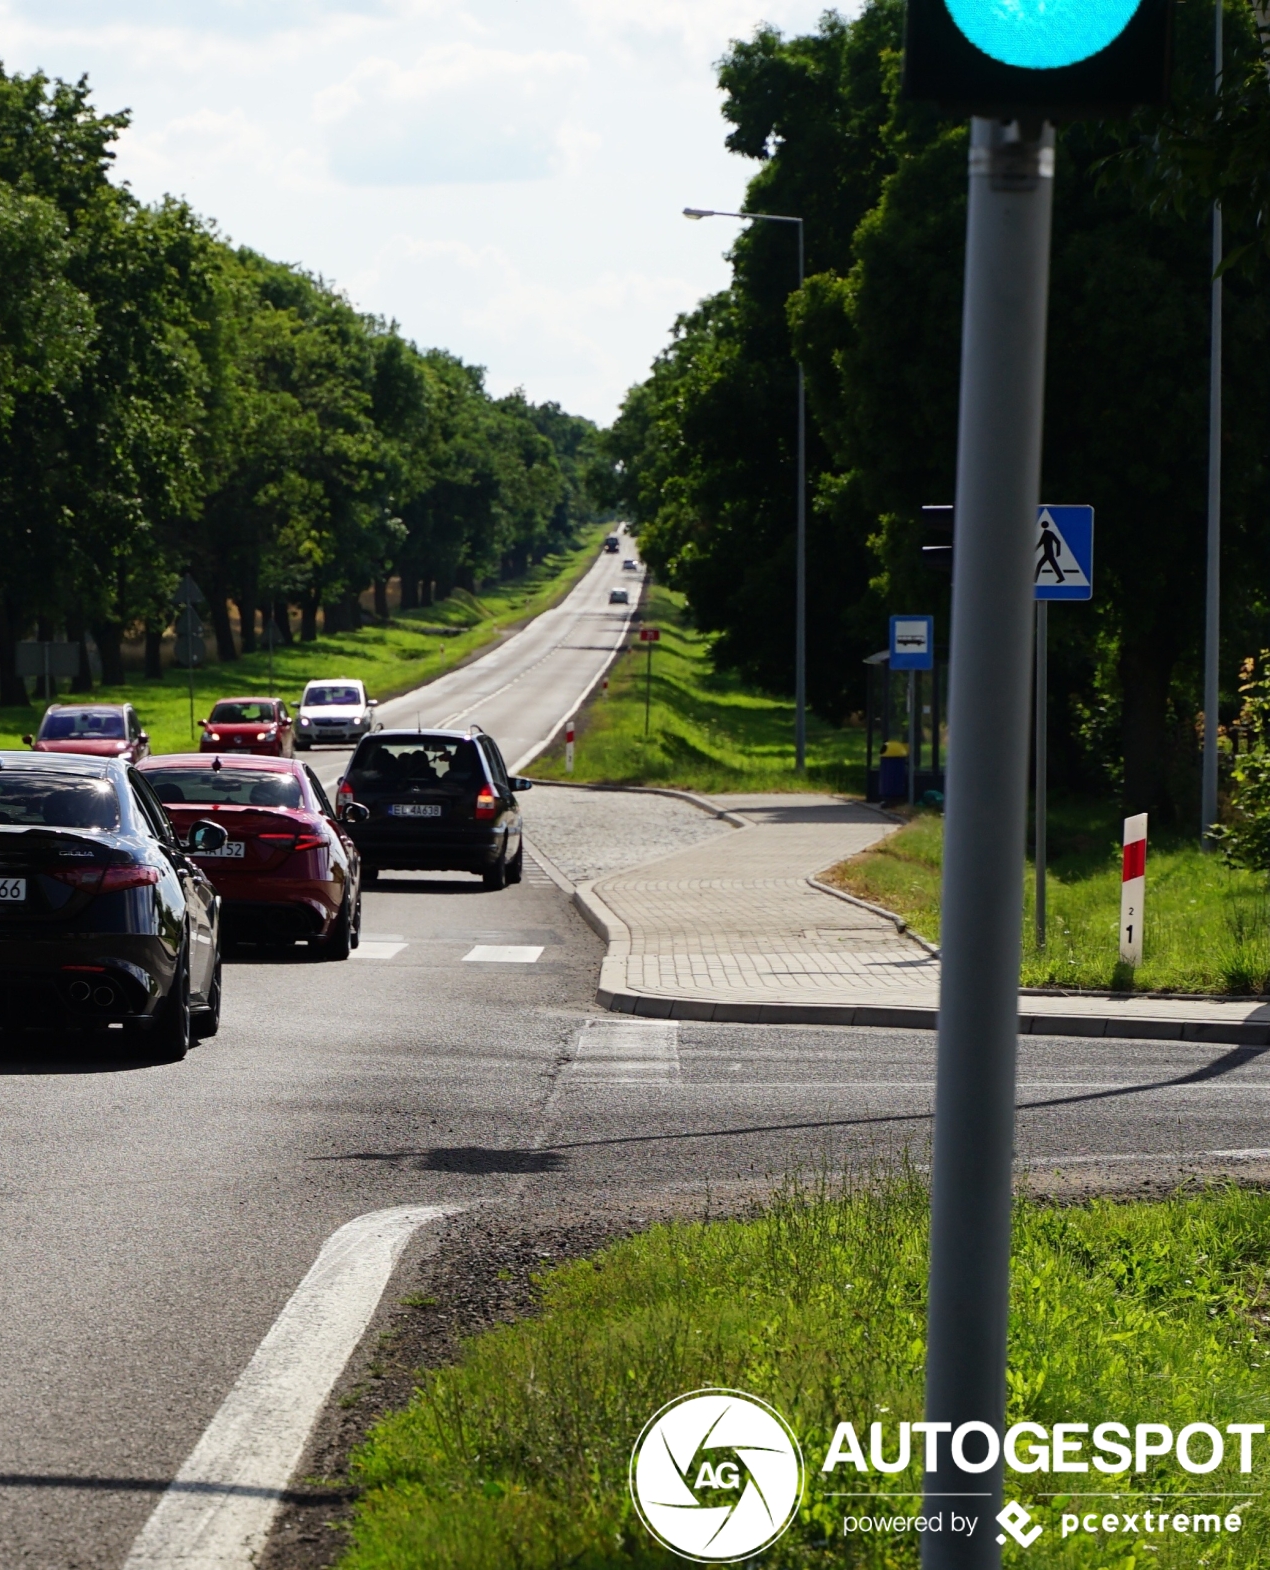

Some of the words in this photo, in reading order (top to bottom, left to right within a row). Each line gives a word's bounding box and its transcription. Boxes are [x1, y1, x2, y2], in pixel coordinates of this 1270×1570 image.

[394, 805, 407, 815] EL
[1128, 906, 1135, 916] 2
[1125, 924, 1134, 944] 1
